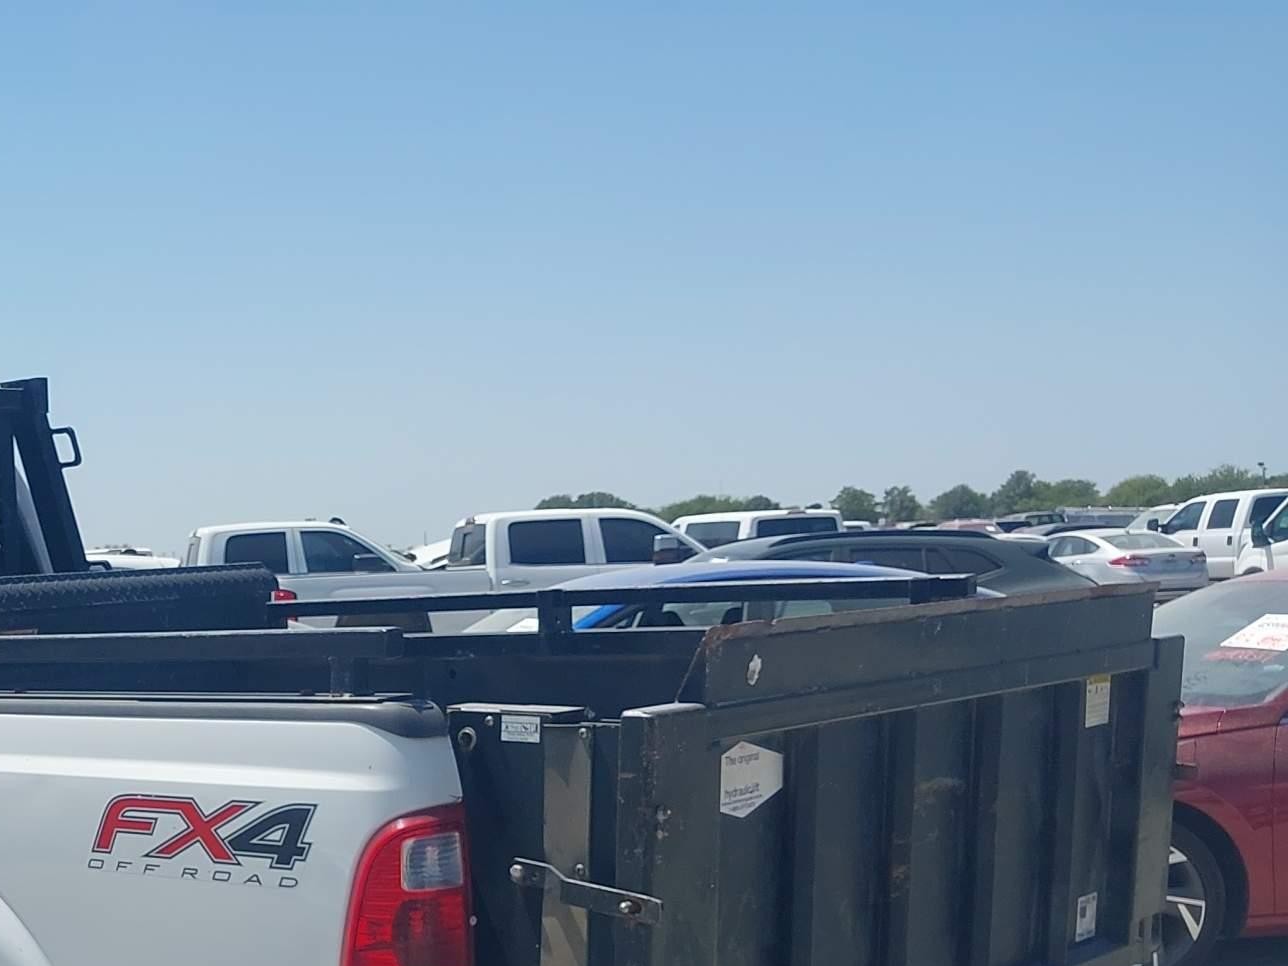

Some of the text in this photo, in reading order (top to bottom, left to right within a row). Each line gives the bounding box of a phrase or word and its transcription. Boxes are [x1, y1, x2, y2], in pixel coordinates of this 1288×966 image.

[91, 793, 318, 870] FX4
[87, 859, 299, 888] OFF ROAD
